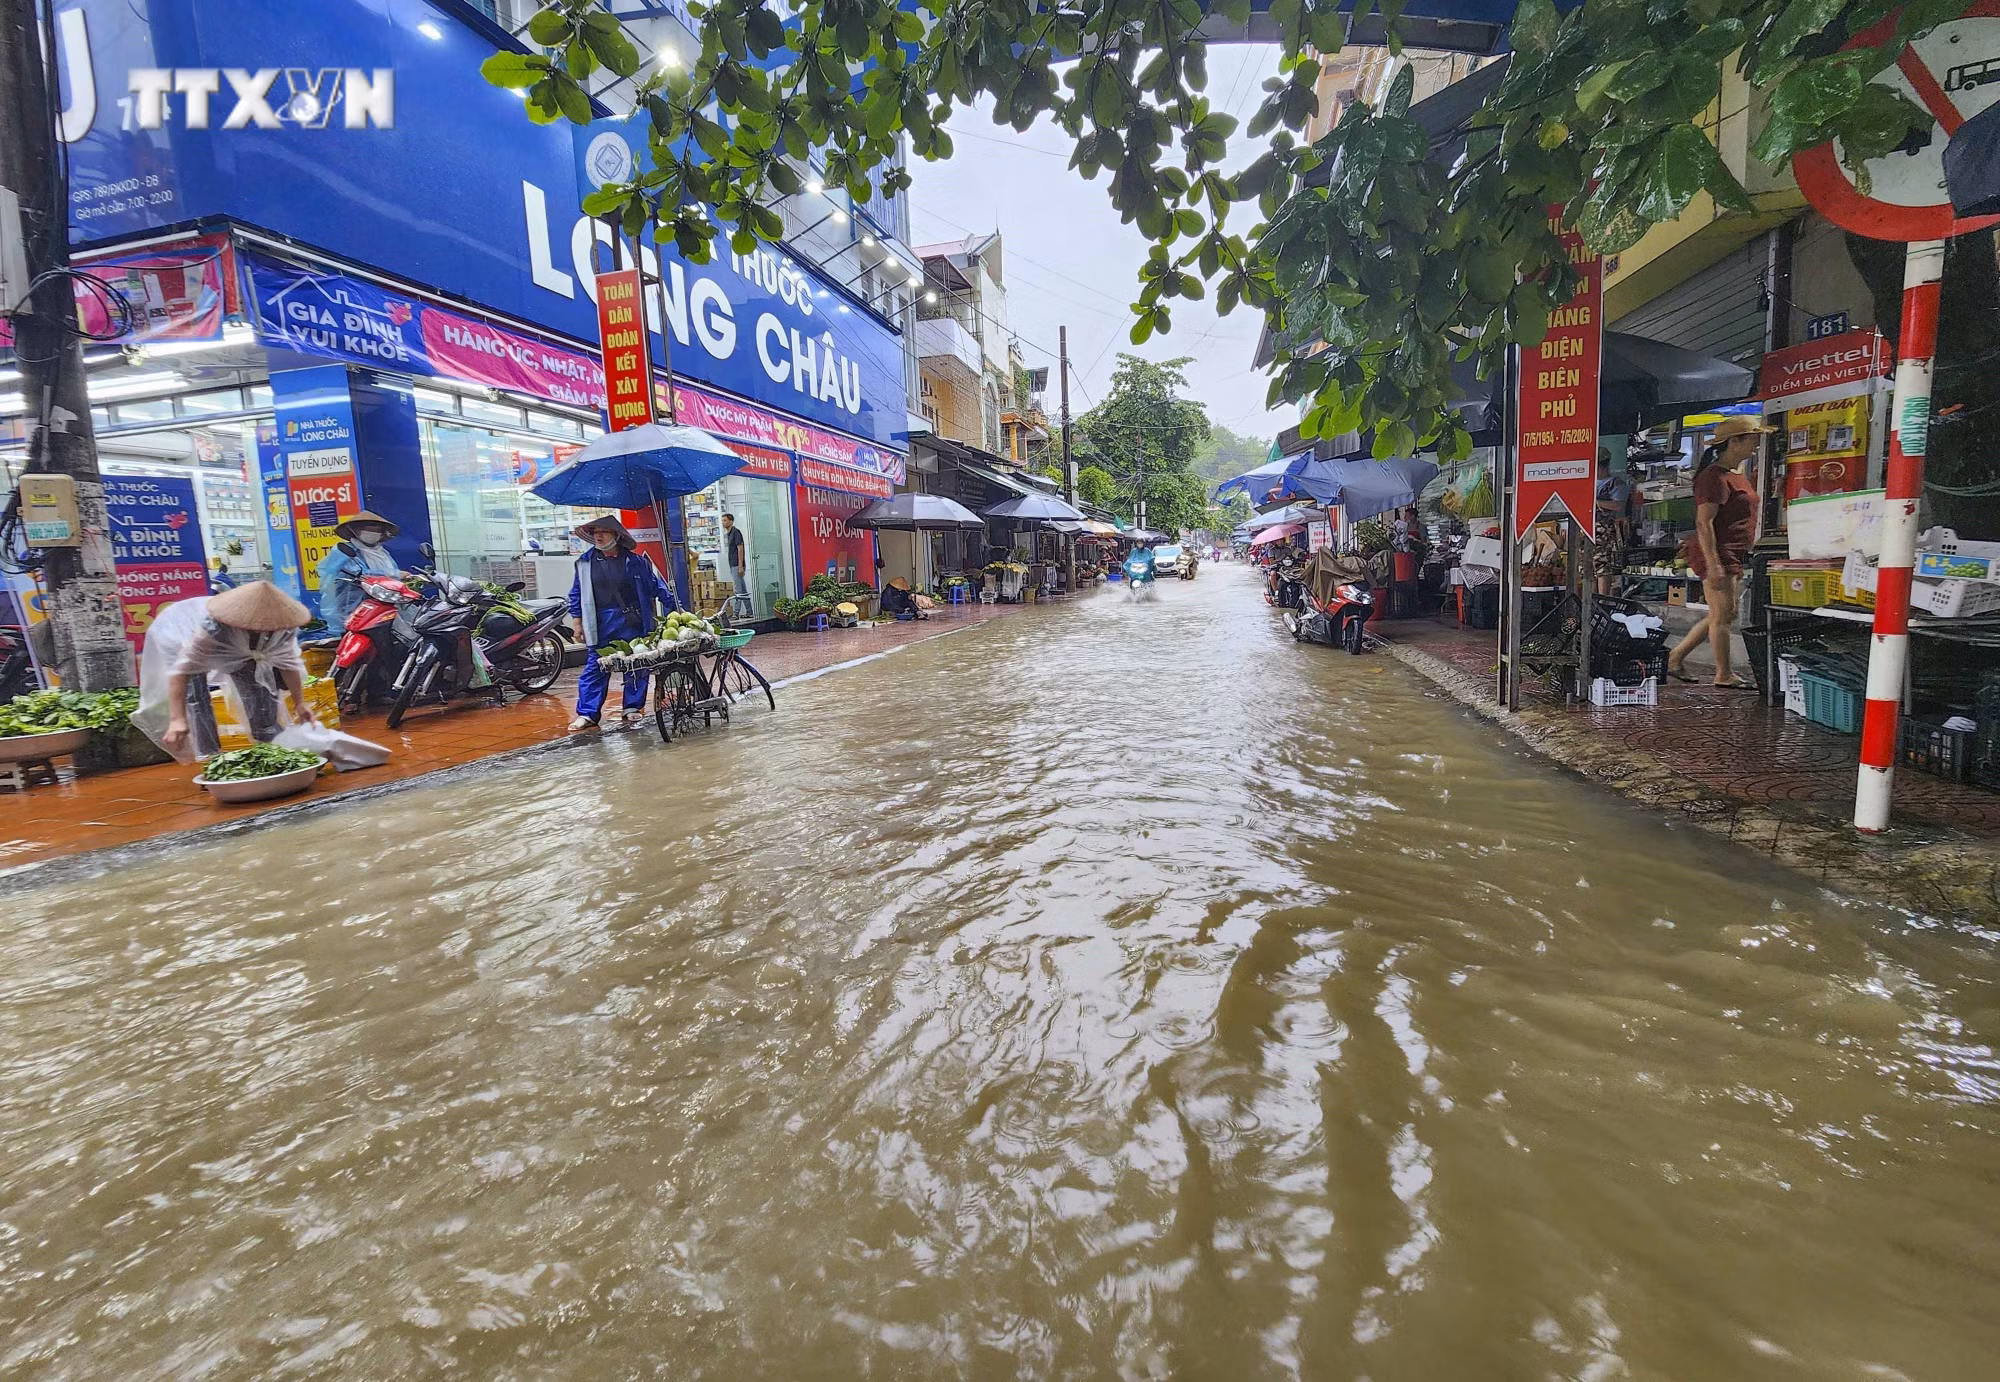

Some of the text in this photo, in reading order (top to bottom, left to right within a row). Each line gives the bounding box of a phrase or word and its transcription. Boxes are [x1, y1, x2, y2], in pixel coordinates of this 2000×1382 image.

[523, 180, 736, 360] LONG
[756, 312, 860, 415] CHÂU
[603, 281, 633, 301] TOÀN
[287, 301, 404, 343] GIA ĐÌNH
[608, 305, 632, 324] DÂN
[291, 324, 337, 349] VUI
[607, 328, 639, 348] ĐOÀN
[443, 324, 506, 358] HÀNG
[508, 341, 539, 370] ÚC,
[542, 354, 591, 385] NHẬT,
[1541, 336, 1584, 361] ĐIỆN
[615, 351, 636, 371] KẾT
[1783, 344, 1872, 375] viettel
[616, 376, 638, 395] XÂY
[1538, 367, 1580, 390] BIÊN
[1770, 361, 1889, 393] ĐIỂM BÁN VIETTEL
[549, 382, 587, 405] GIẢM
[614, 401, 646, 420] DỰNG
[1540, 393, 1576, 419] PHỦ
[300, 416, 338, 430] NHÀ THUỐC
[705, 402, 773, 433] DƯỢC MỸ PHẨM
[302, 431, 326, 442] LONG
[326, 427, 349, 440] CHÂU
[1523, 431, 1554, 448] (7/5/1954
[1560, 428, 1593, 445] 7/5/2024)
[291, 454, 348, 470] TUYỂN DỤNG
[770, 458, 789, 474] VIỆN
[1527, 466, 1585, 477] mobifone
[118, 481, 159, 492] THUỐC
[802, 466, 829, 481] CHUYÊN
[830, 473, 844, 485] ĐƠN
[845, 474, 864, 489] THUỐC
[104, 493, 179, 506] ONG CHÂU
[337, 483, 352, 503] SĨ
[130, 527, 180, 543] ĐÌNH
[302, 529, 318, 539] THU
[811, 512, 832, 544] TẬP
[132, 541, 182, 557] KHỎE
[305, 547, 319, 561] 10
[116, 567, 202, 583] HỐNG NẮNG
